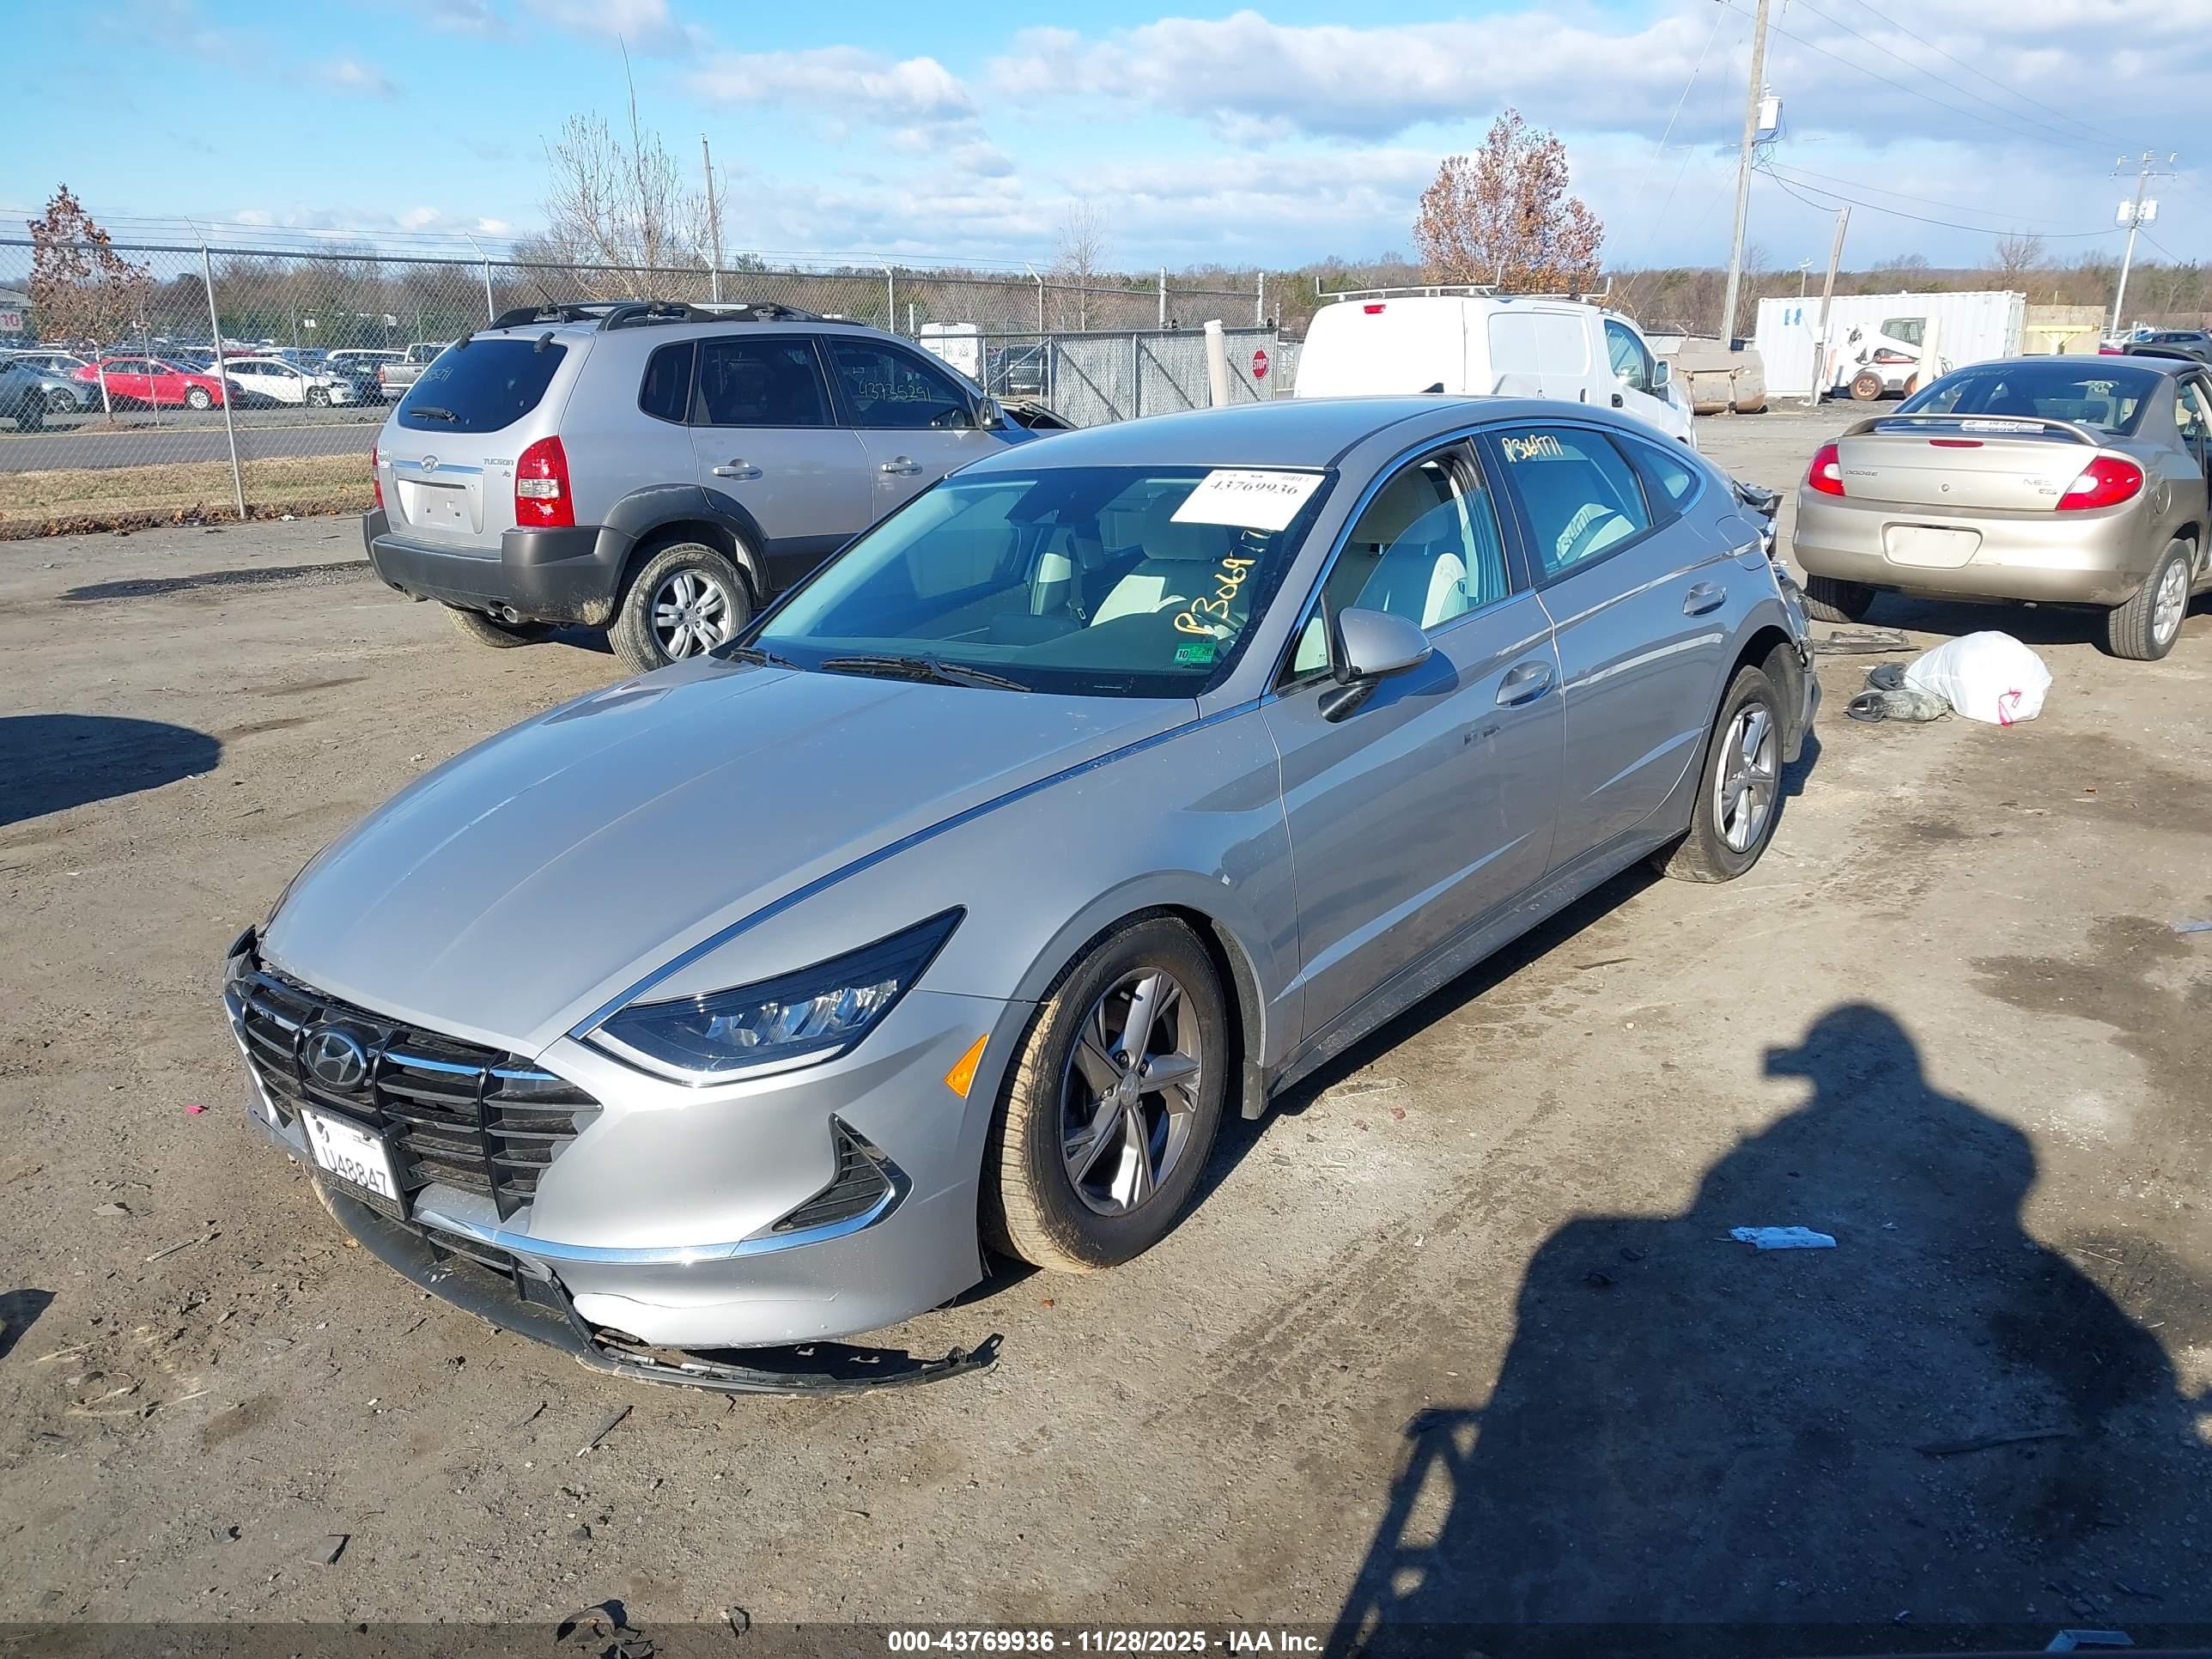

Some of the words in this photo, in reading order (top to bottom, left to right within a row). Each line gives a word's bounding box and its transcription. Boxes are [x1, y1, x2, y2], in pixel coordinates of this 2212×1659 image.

[1253, 358, 1267, 370] STOP
[859, 380, 932, 402] 43735291
[483, 458, 514, 466] TUCSON
[1211, 480, 1298, 495] 43769936
[1178, 649, 1189, 659] 10
